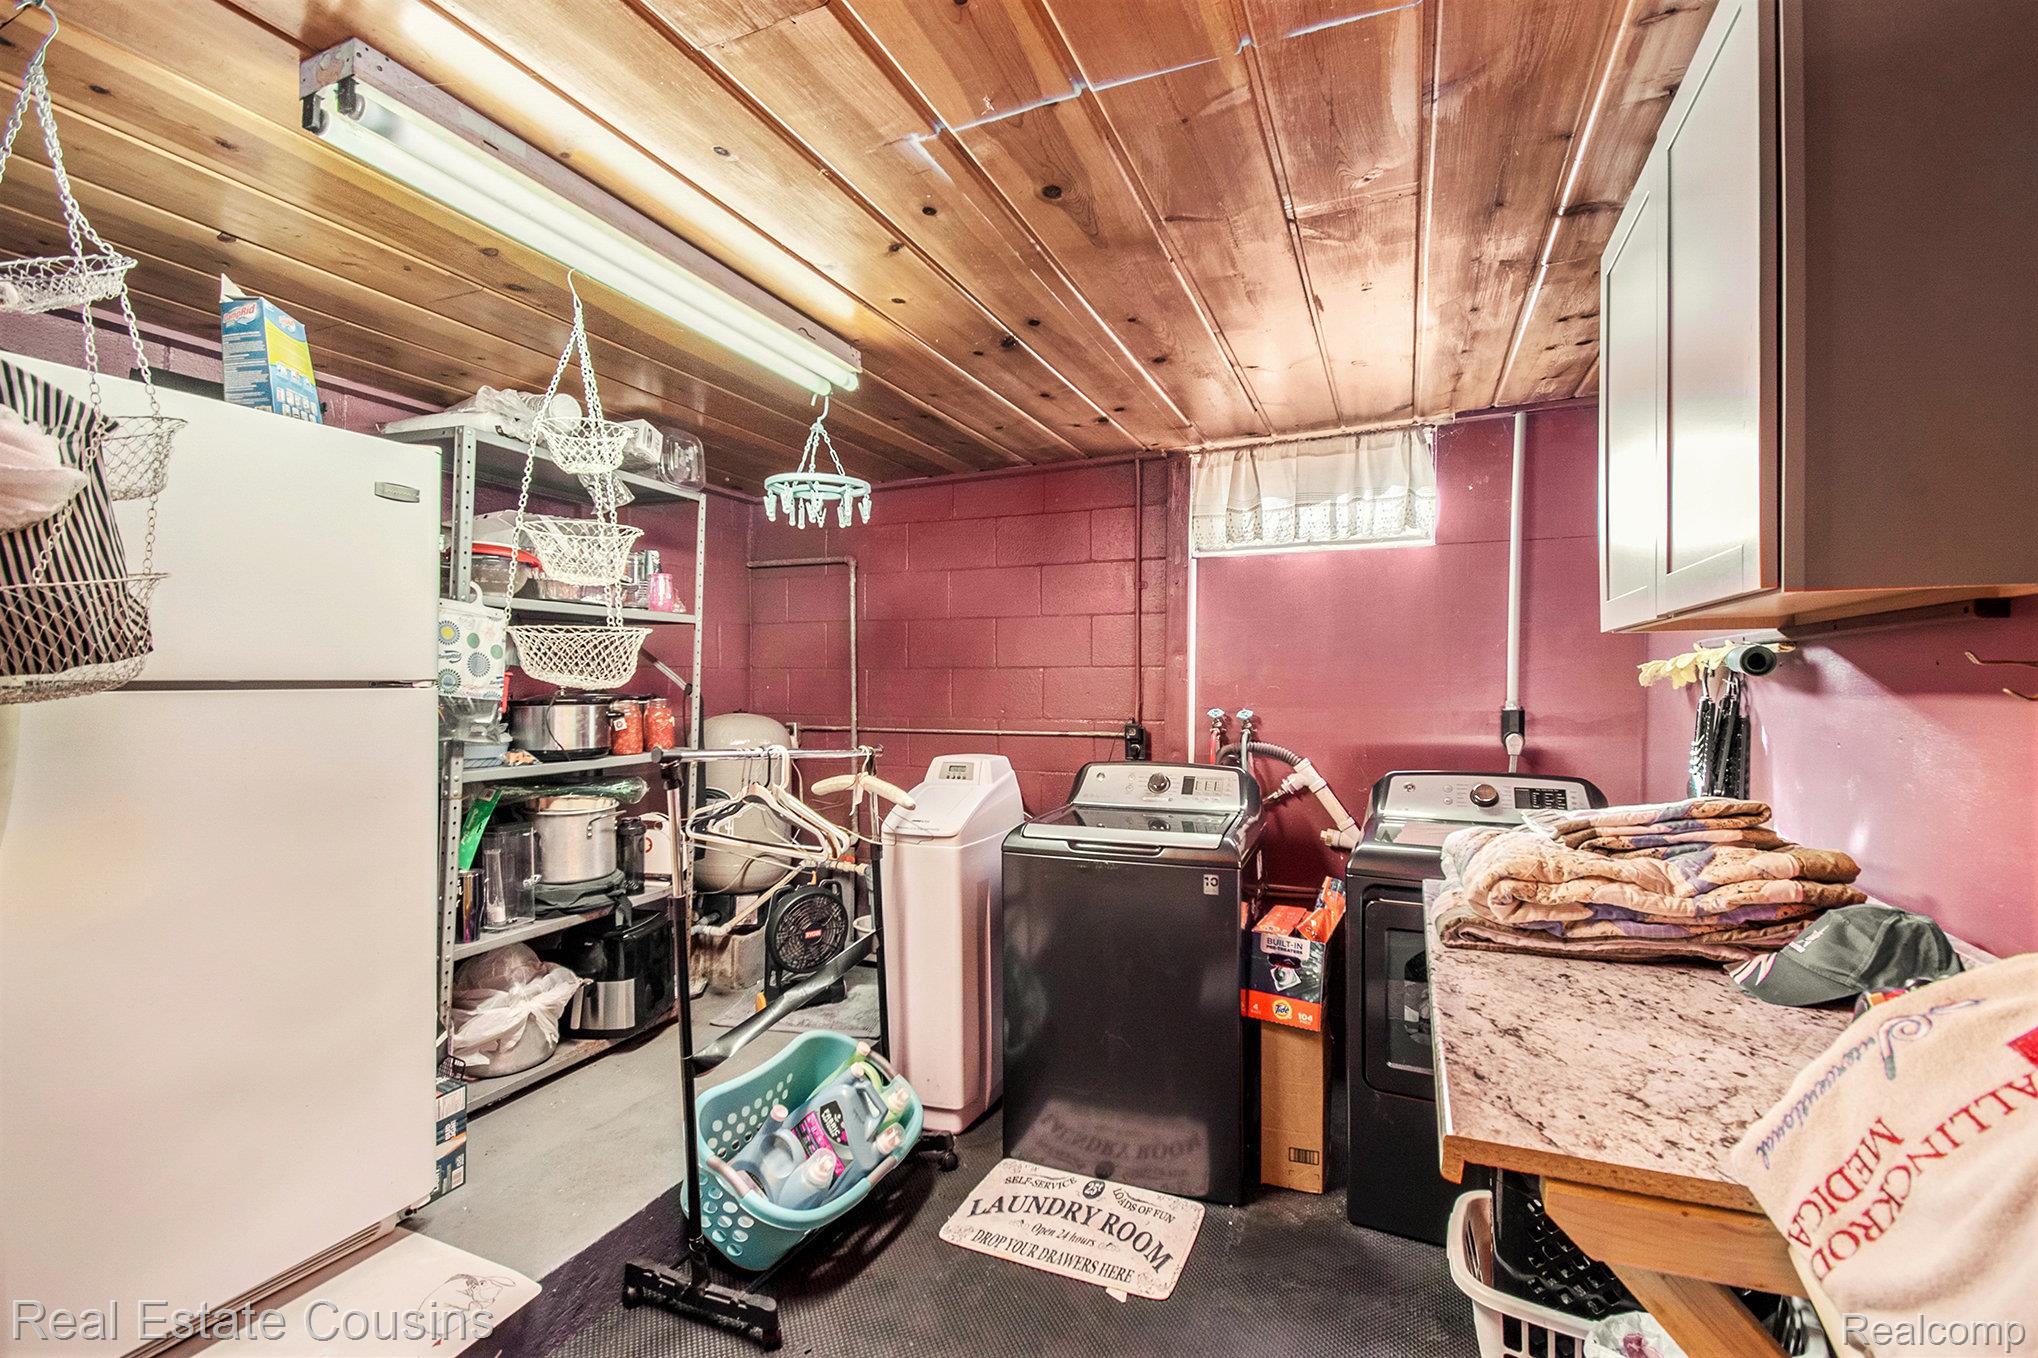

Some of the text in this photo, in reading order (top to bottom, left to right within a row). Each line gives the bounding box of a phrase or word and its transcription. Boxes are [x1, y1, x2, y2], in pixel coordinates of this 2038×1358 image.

[1266, 937, 1303, 950] BUILT-IN
[1274, 1004, 1290, 1014] Tide
[1004, 1176, 1078, 1191] SELF-SERVICE
[1137, 1204, 1152, 1216] OF
[1152, 1208, 1176, 1224] FUN
[967, 1195, 1174, 1274] LAUNDRY ROOM
[1031, 1222, 1095, 1248] Open 24 hours
[971, 1229, 1135, 1284] DROP YOUR DRAWERS HERE
